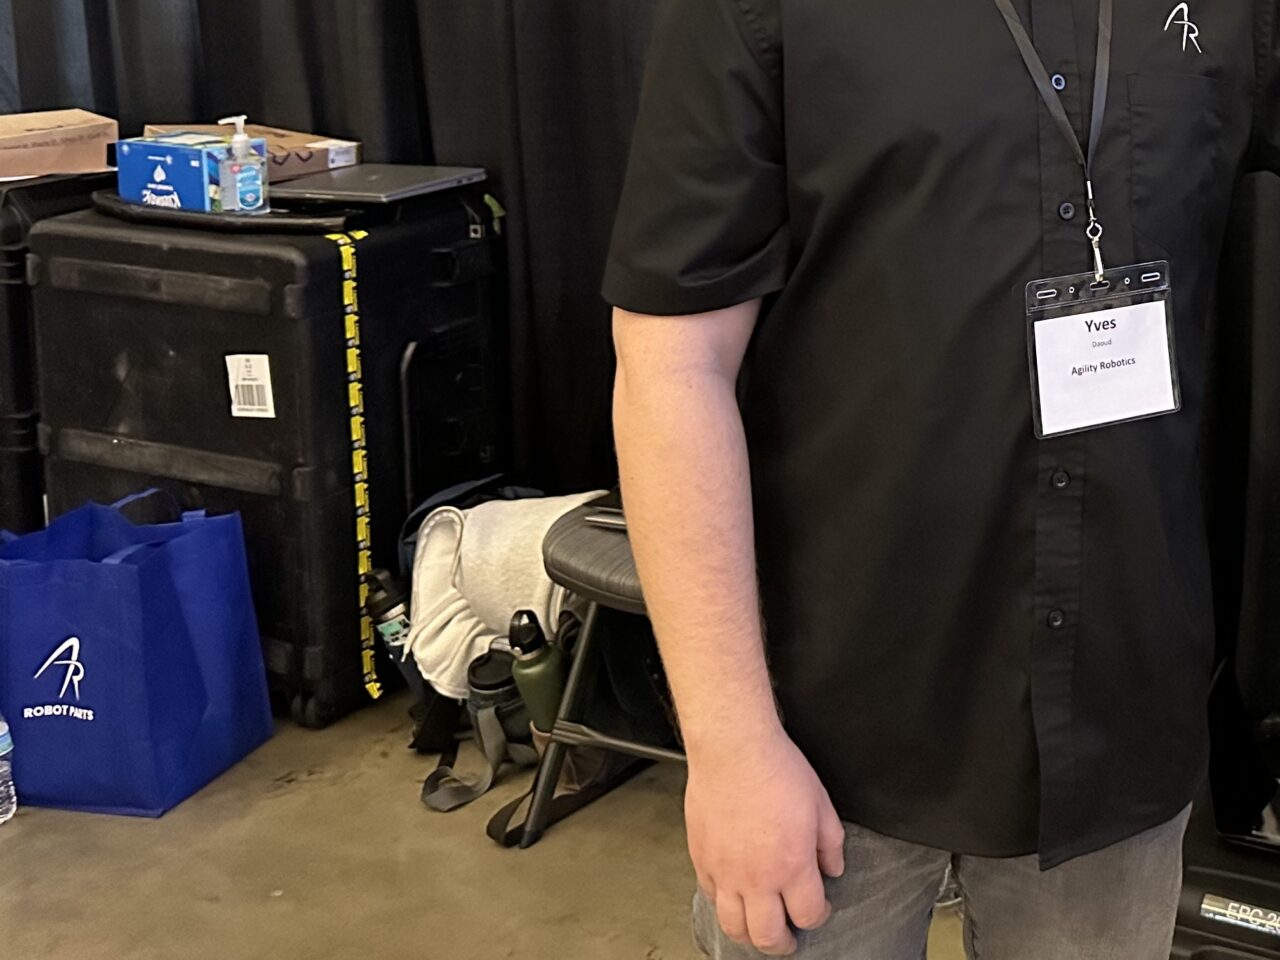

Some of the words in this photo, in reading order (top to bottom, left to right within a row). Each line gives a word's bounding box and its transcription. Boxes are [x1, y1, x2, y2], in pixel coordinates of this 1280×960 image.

[1085, 319, 1116, 332] Yves
[1072, 365, 1097, 376] Agility
[1100, 358, 1135, 370] Robotics
[24, 705, 68, 718] ROBOT
[69, 706, 94, 720] PARTS
